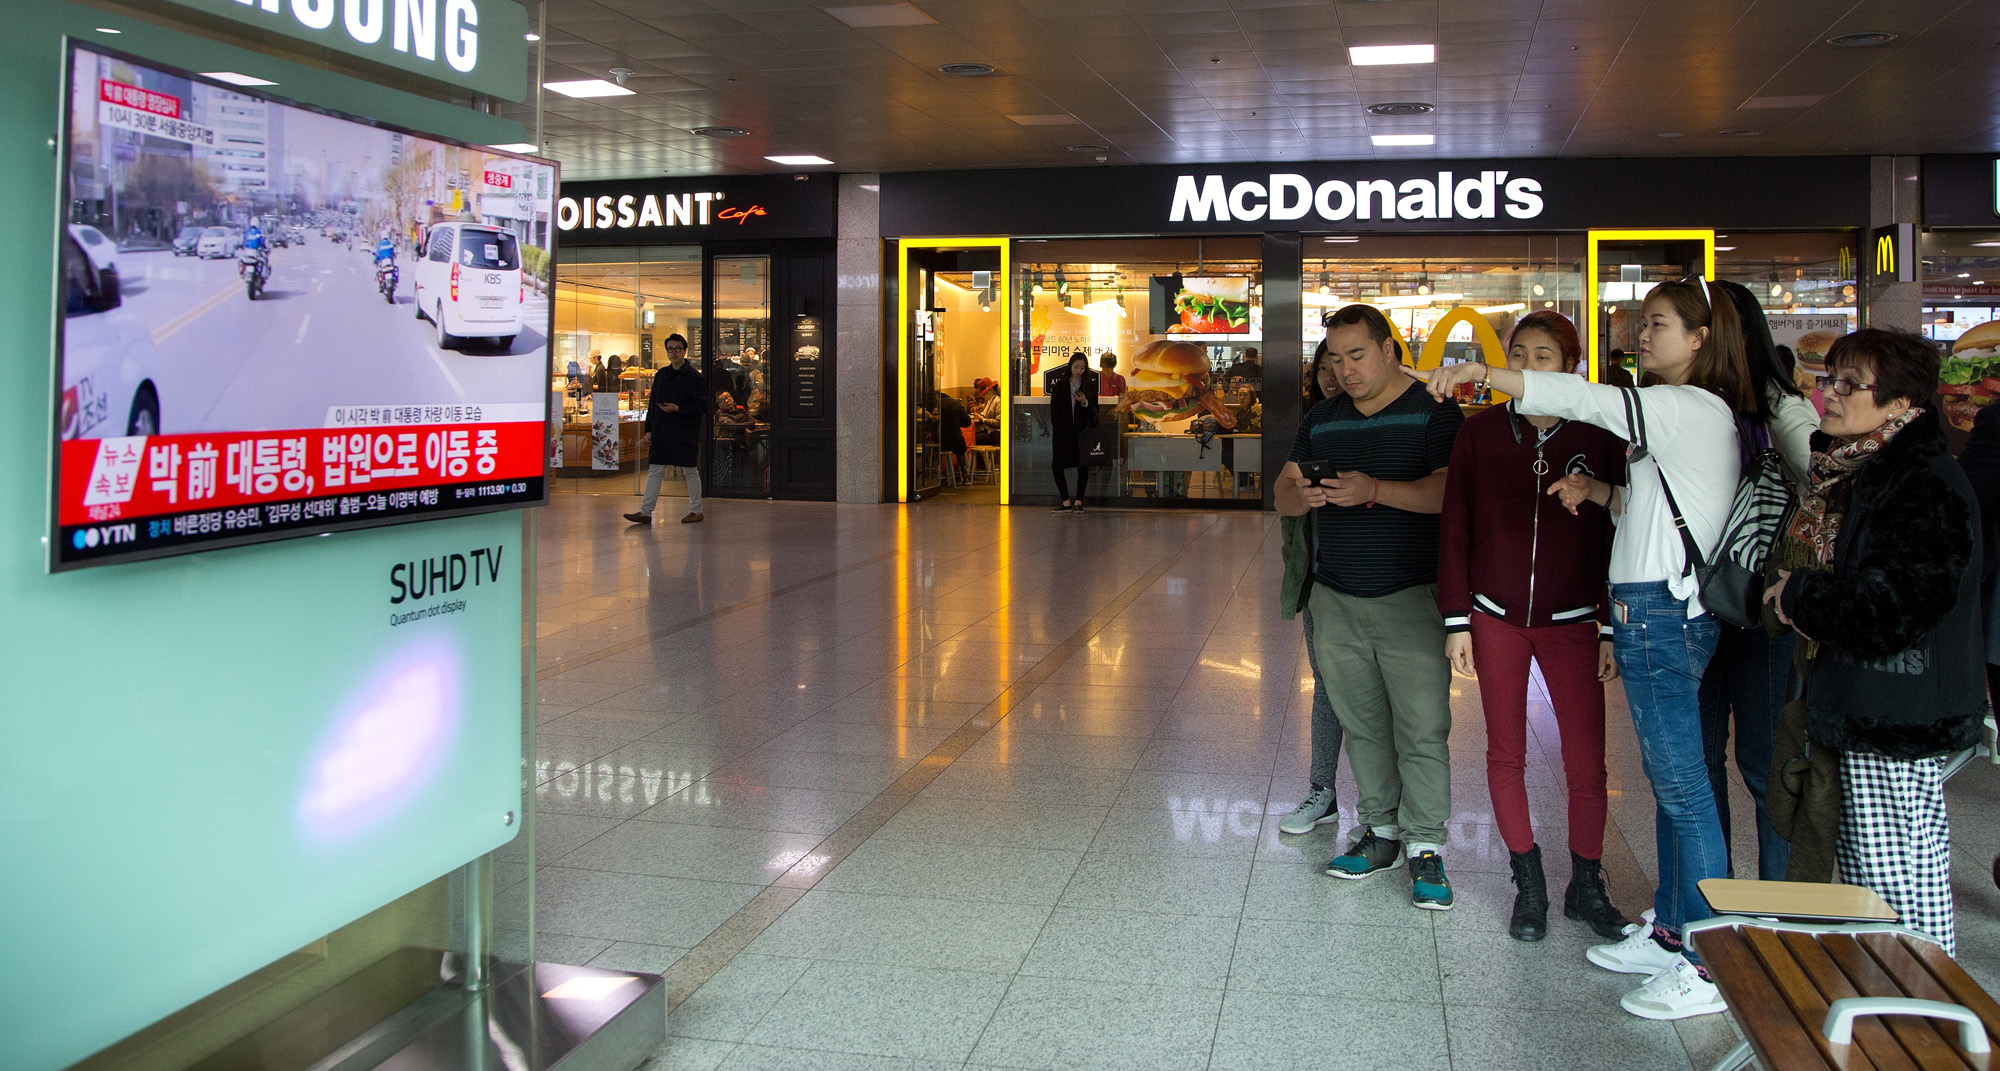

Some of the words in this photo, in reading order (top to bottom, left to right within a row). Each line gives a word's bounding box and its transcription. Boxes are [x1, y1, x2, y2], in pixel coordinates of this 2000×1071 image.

[108, 107, 132, 126] 10시
[134, 112, 156, 132] 30분
[158, 119, 213, 145] 서울중앙지법
[487, 170, 509, 187] 생중계
[1169, 171, 1544, 222] McDonald's
[557, 190, 718, 231] OISSANT
[484, 274, 502, 284] KBS
[1768, 319, 1804, 330] 햄버거를
[1806, 319, 1843, 330] 즐기세요!
[1032, 345, 1070, 357] 프리미엄
[335, 408, 345, 426] 이
[347, 408, 368, 425] 시각
[370, 407, 380, 424] 박
[395, 406, 422, 424] 대통령
[424, 406, 443, 422] 차량
[445, 406, 462, 421] 이동
[464, 405, 482, 421] 모습
[103, 444, 137, 467] 뉴스
[149, 443, 182, 504] 박
[187, 442, 219, 501] 前
[226, 436, 315, 496] 대통령,
[322, 433, 419, 488] 법원으로
[425, 430, 471, 477] 이동
[475, 429, 498, 475] 중
[95, 473, 130, 497] 속보
[478, 484, 505, 497] 1113.90
[511, 482, 527, 494] 0.30
[149, 519, 171, 539] 정치
[174, 511, 222, 536] 바른정당
[225, 506, 262, 530] 유승민,
[388, 491, 417, 509] 이명박
[419, 488, 438, 506] 예방
[100, 523, 136, 545] YTN
[390, 553, 466, 604] SUHD
[470, 545, 503, 586] TV
[390, 610, 426, 627] Quantum
[427, 604, 440, 618] dot
[441, 598, 467, 615] display
[1679, 987, 1692, 997] FILA
